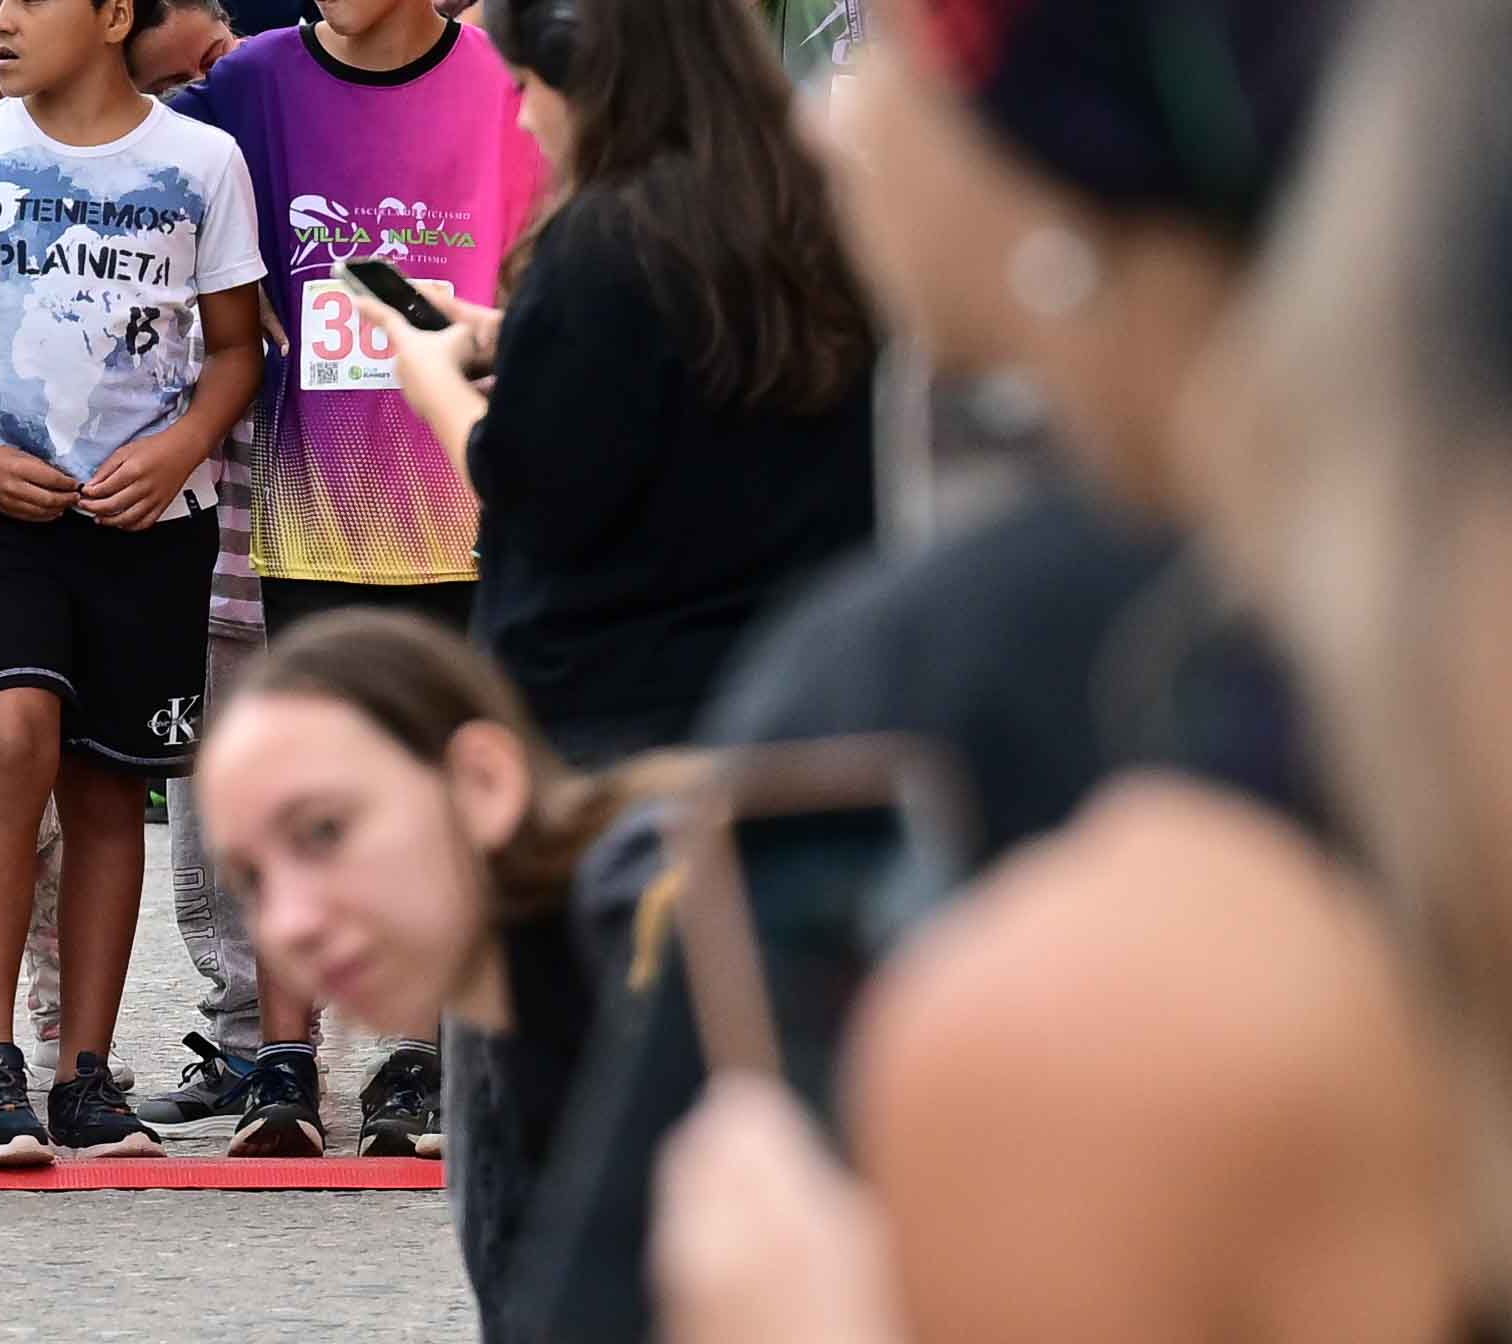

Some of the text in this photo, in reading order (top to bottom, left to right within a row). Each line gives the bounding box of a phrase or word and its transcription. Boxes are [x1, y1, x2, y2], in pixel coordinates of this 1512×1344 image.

[15, 197, 177, 235] TENEMOS
[294, 226, 476, 248] VILLA NUEVA
[126, 306, 161, 355] B
